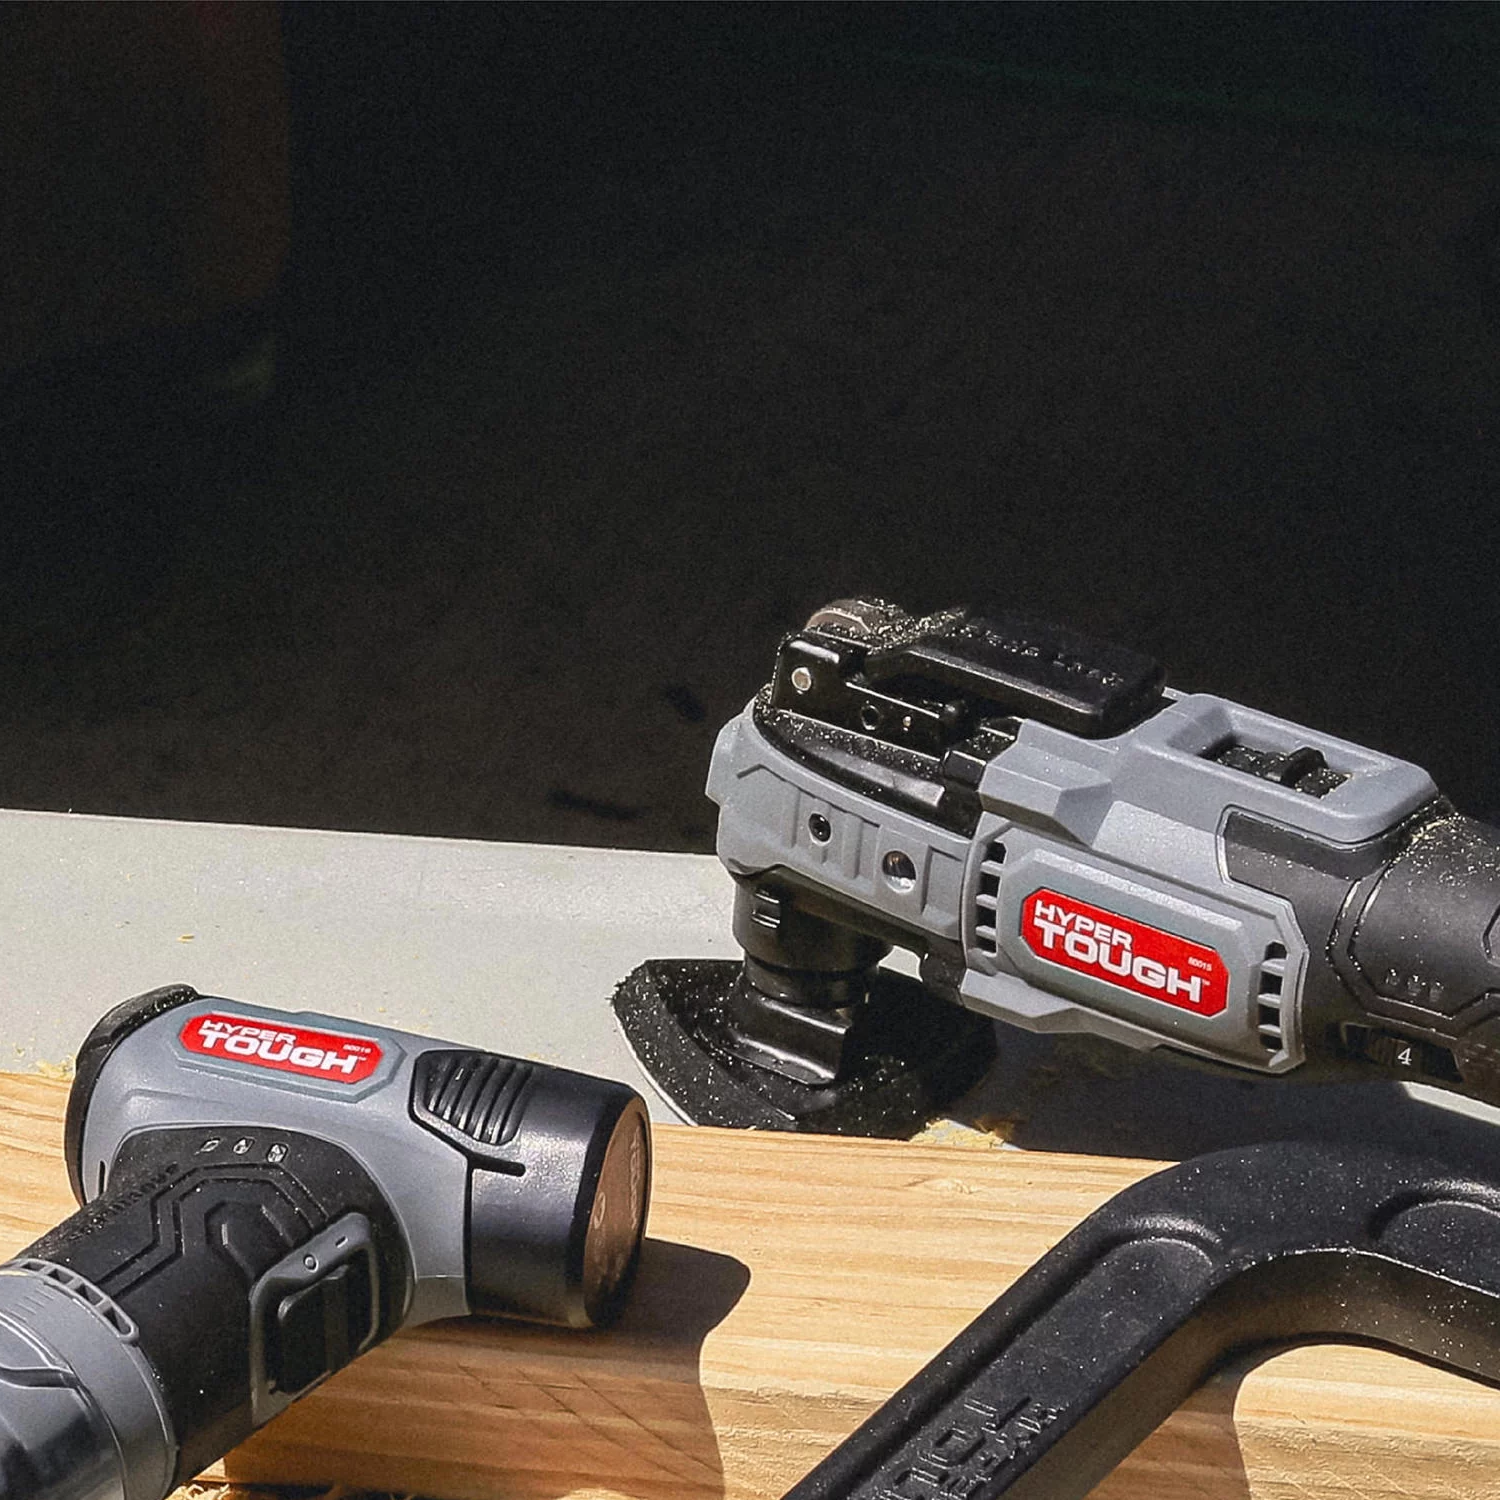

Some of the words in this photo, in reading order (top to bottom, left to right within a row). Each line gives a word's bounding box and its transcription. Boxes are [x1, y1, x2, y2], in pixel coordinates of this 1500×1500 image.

[1035, 900, 1134, 950] HYPER
[1033, 917, 1202, 1004] TOUGH
[198, 1029, 360, 1074] TOUGH
[201, 1019, 298, 1046] HYPER
[1397, 1047, 1413, 1066] 4
